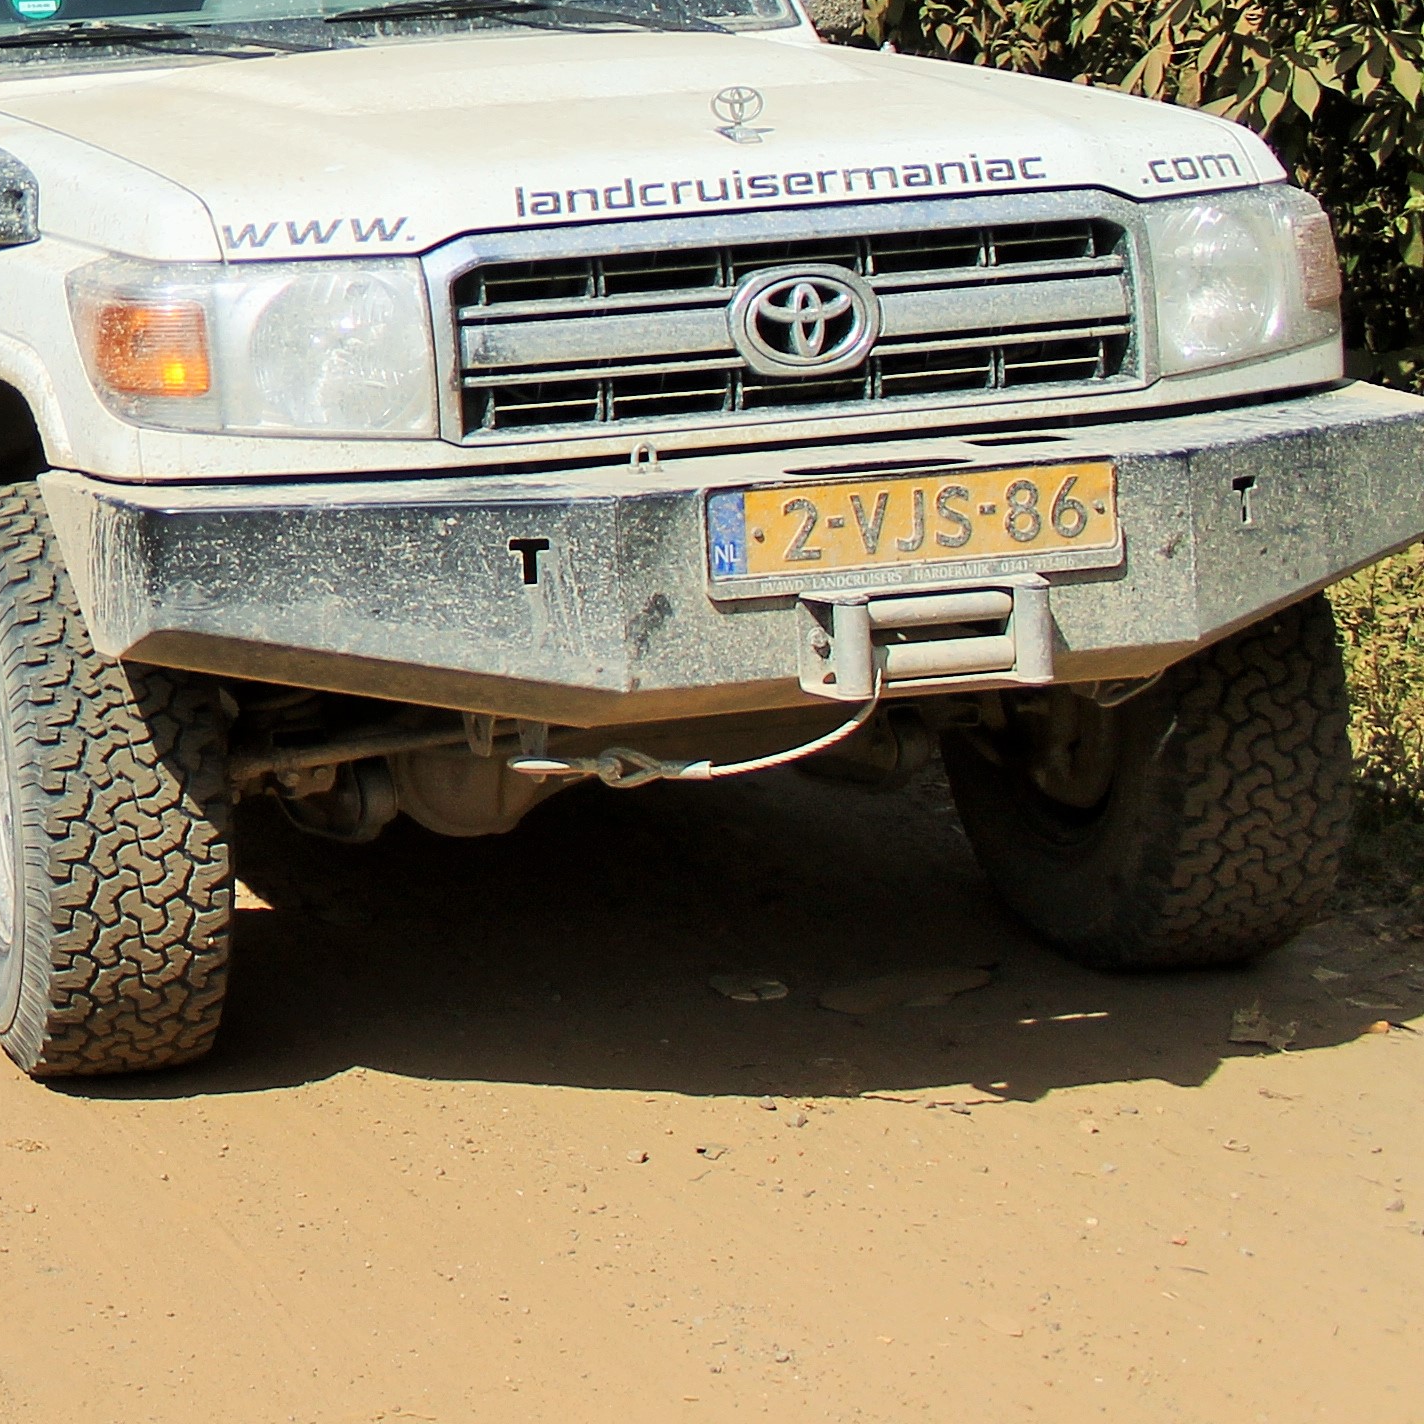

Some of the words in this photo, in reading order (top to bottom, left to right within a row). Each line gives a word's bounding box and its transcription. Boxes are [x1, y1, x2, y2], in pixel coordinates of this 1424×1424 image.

[222, 215, 416, 249] www.
[513, 153, 1046, 218] landcruisermaniac
[1140, 150, 1242, 185] .com
[714, 543, 739, 565] NL
[783, 475, 1088, 562] 2-VJS-86
[812, 570, 902, 590] LANDCRUISERS
[914, 562, 990, 581] HARDERWIJK
